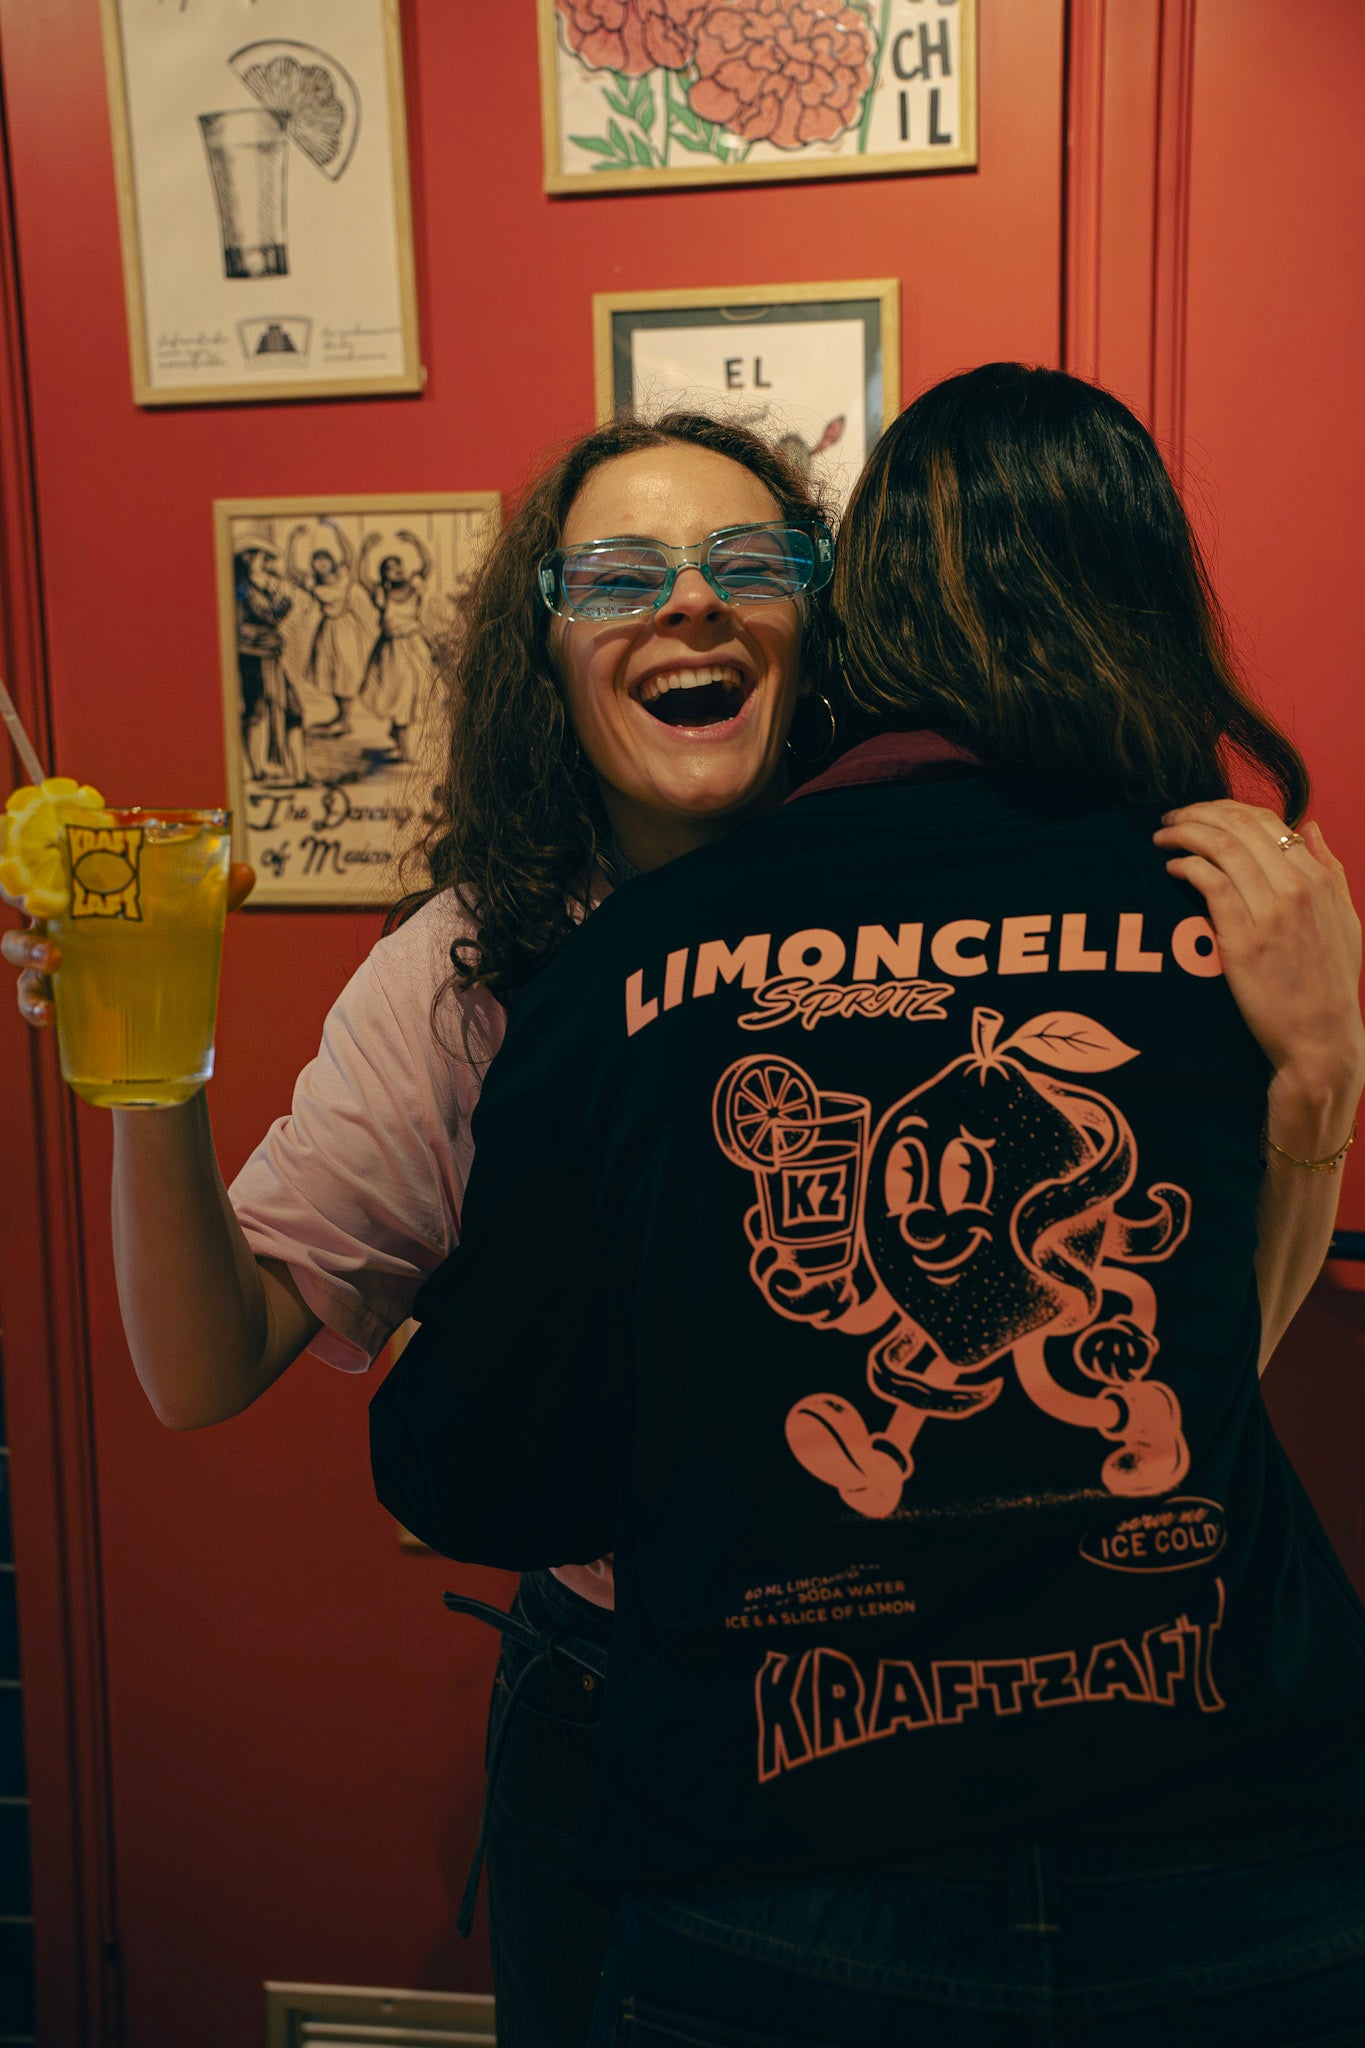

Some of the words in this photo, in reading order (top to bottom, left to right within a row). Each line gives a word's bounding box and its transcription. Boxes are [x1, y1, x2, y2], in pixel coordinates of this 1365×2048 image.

[893, 19, 951, 80] CH
[725, 356, 771, 389] EL
[247, 793, 310, 831] The
[260, 840, 292, 878] of
[626, 912, 1224, 1037] LIMONCELLO
[786, 1170, 844, 1221] KZ
[1101, 1532, 1147, 1559] ICE
[1154, 1522, 1219, 1554] COLD
[744, 1587, 763, 1602] 60
[765, 1583, 784, 1596] ML
[847, 1580, 905, 1598] WATER
[725, 1615, 750, 1629] ICE
[767, 1614, 778, 1627] A
[780, 1607, 828, 1626] SLICE
[831, 1604, 854, 1620] OF
[858, 1599, 917, 1617] LEMON
[755, 1576, 1226, 1783] KRAFTZAFT
